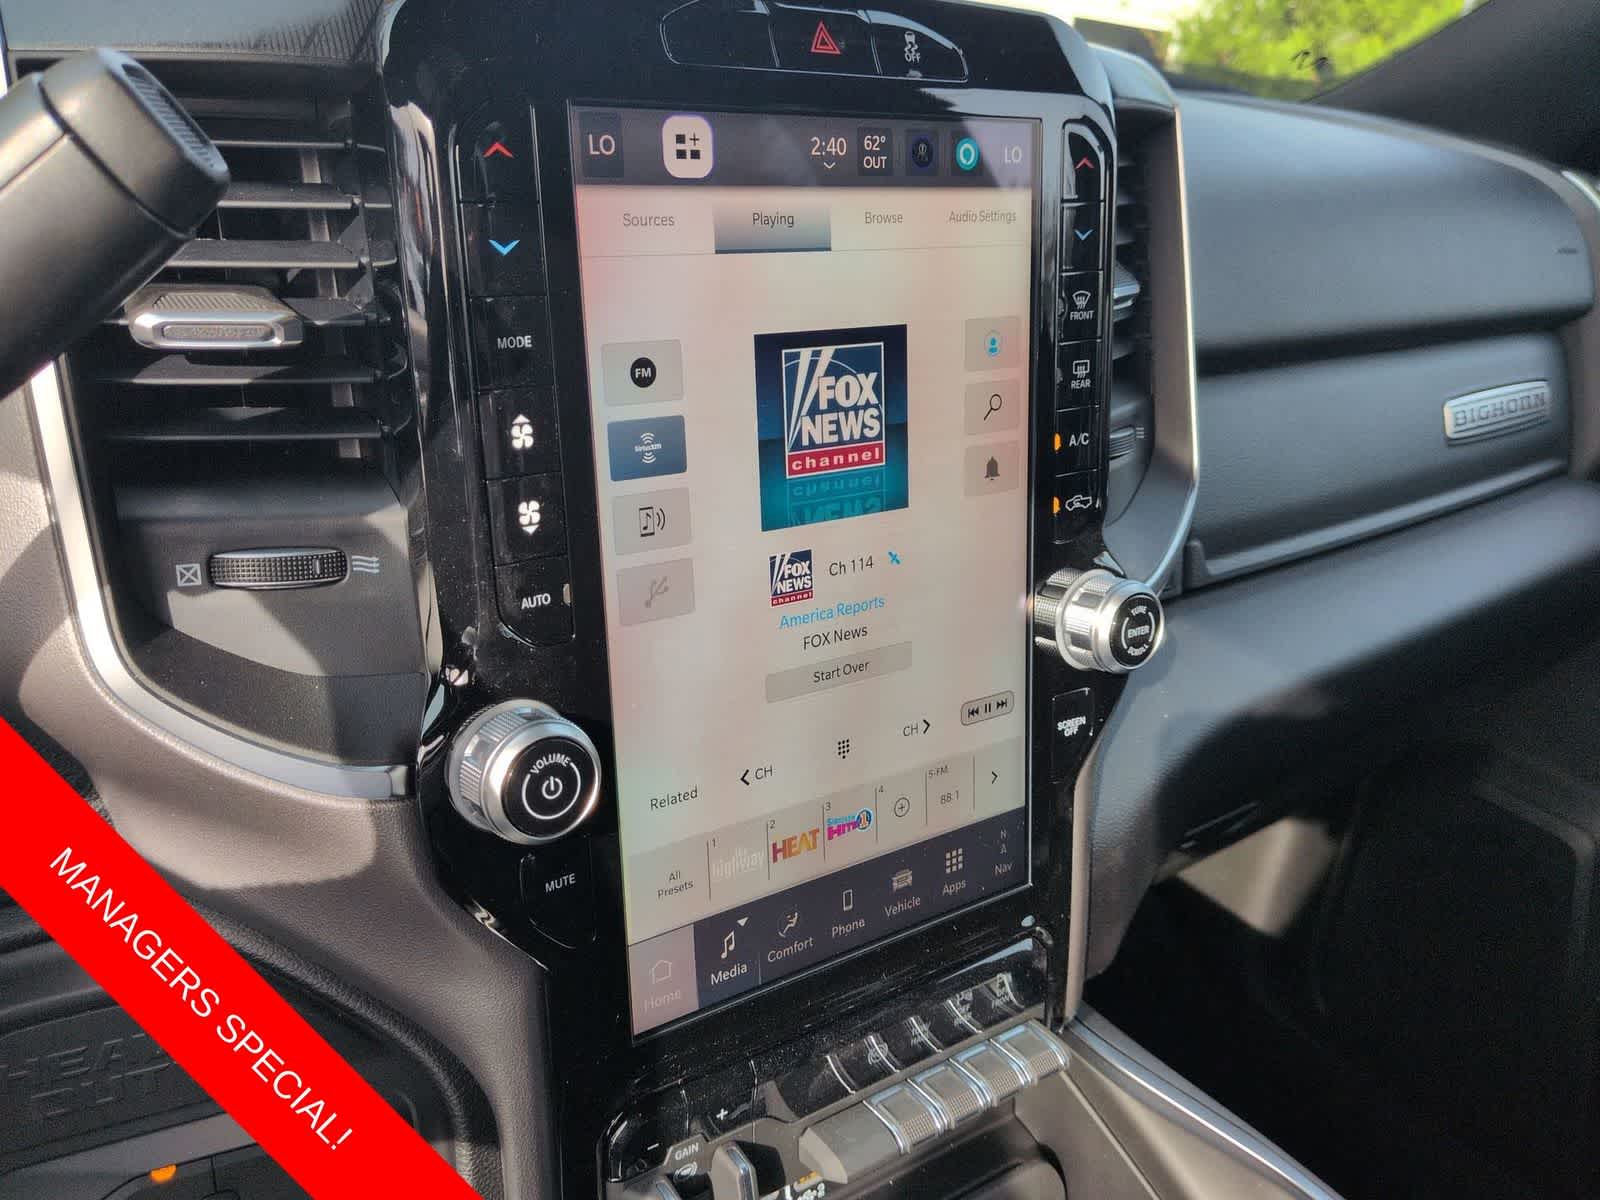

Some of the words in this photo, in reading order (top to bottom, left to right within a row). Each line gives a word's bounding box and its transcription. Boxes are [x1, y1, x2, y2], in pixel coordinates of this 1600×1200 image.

[904, 52, 921, 63] OFF
[588, 134, 616, 155] LO
[810, 136, 847, 156] 2:40
[864, 135, 887, 151] 62°
[863, 156, 887, 169] OUT
[1003, 147, 1022, 164] LO
[622, 212, 675, 227] Sources
[752, 211, 795, 228] Playing
[864, 211, 904, 225] Browse
[949, 211, 978, 223] Audio
[978, 210, 1017, 225] Settings
[1069, 310, 1095, 321] FRONT
[497, 335, 532, 349] MODE
[634, 367, 652, 379] FM
[818, 372, 879, 410] FOX
[1070, 379, 1091, 389] REAR
[1454, 392, 1545, 428] BIGHORN
[801, 407, 880, 447] NEWS
[1069, 432, 1090, 446] A/C
[791, 447, 880, 471] channel
[783, 560, 811, 579] FOX
[828, 562, 847, 576] Ch
[850, 555, 874, 572] 114
[775, 575, 812, 594] NEWS
[521, 592, 551, 610] AUTO
[779, 609, 834, 630] America
[836, 597, 885, 617] Reports
[803, 632, 832, 650] FOX
[833, 626, 868, 644] News
[1127, 624, 1150, 639] ENTER
[813, 667, 841, 683] Start
[842, 660, 870, 676] Over
[903, 723, 919, 737] CH
[1057, 716, 1086, 731] SCREEN
[1063, 727, 1079, 737] OFF
[530, 753, 571, 775] VOLUME
[754, 765, 774, 780] CH
[650, 785, 698, 811] Related
[825, 801, 831, 811] 3
[769, 819, 776, 829] 2
[772, 827, 820, 864] HEAT
[668, 871, 681, 882] All
[994, 863, 1013, 876] Nav
[545, 873, 576, 893] MUTE
[657, 881, 694, 899] Presets
[942, 879, 967, 897] Apps
[884, 896, 921, 918] Vehicle
[831, 918, 865, 938] Phone
[767, 937, 814, 963] Comfort
[710, 963, 748, 985] Media
[644, 990, 681, 1012] Home
[674, 1142, 700, 1161] GAIN
